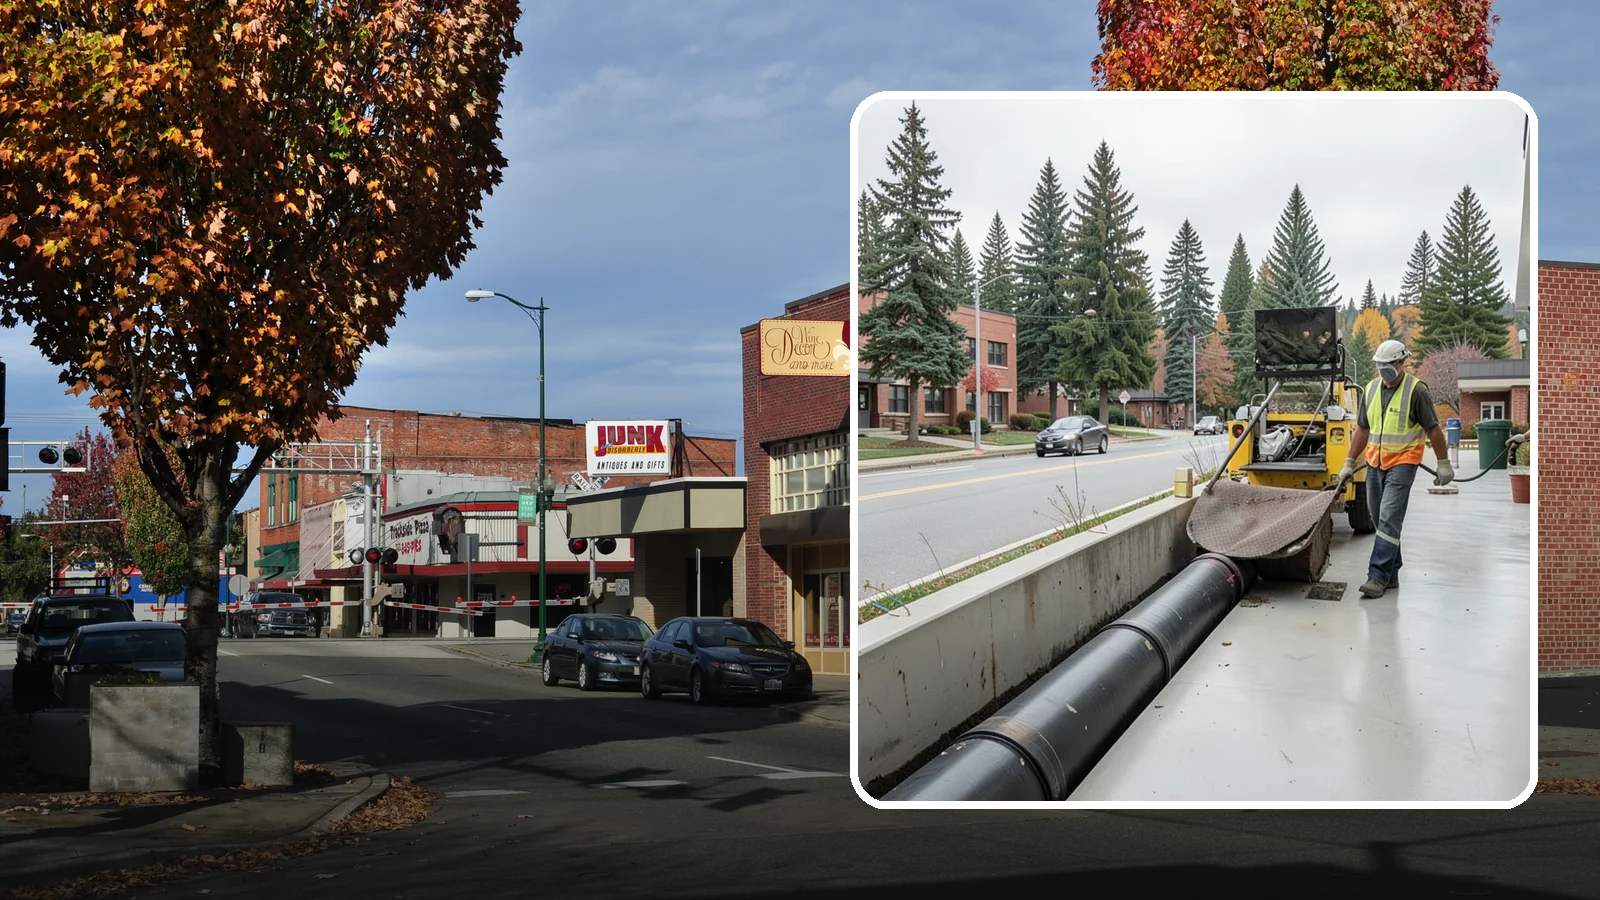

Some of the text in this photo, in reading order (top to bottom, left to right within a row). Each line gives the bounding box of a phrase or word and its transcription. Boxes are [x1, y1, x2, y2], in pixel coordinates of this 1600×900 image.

[595, 425, 666, 457] JUNK
[608, 446, 646, 454] DISORDERLY
[597, 460, 665, 470] ANTIQUES AND GIFTS
[573, 473, 589, 492] RAIL
[390, 520, 429, 539] Trackside Pizza
